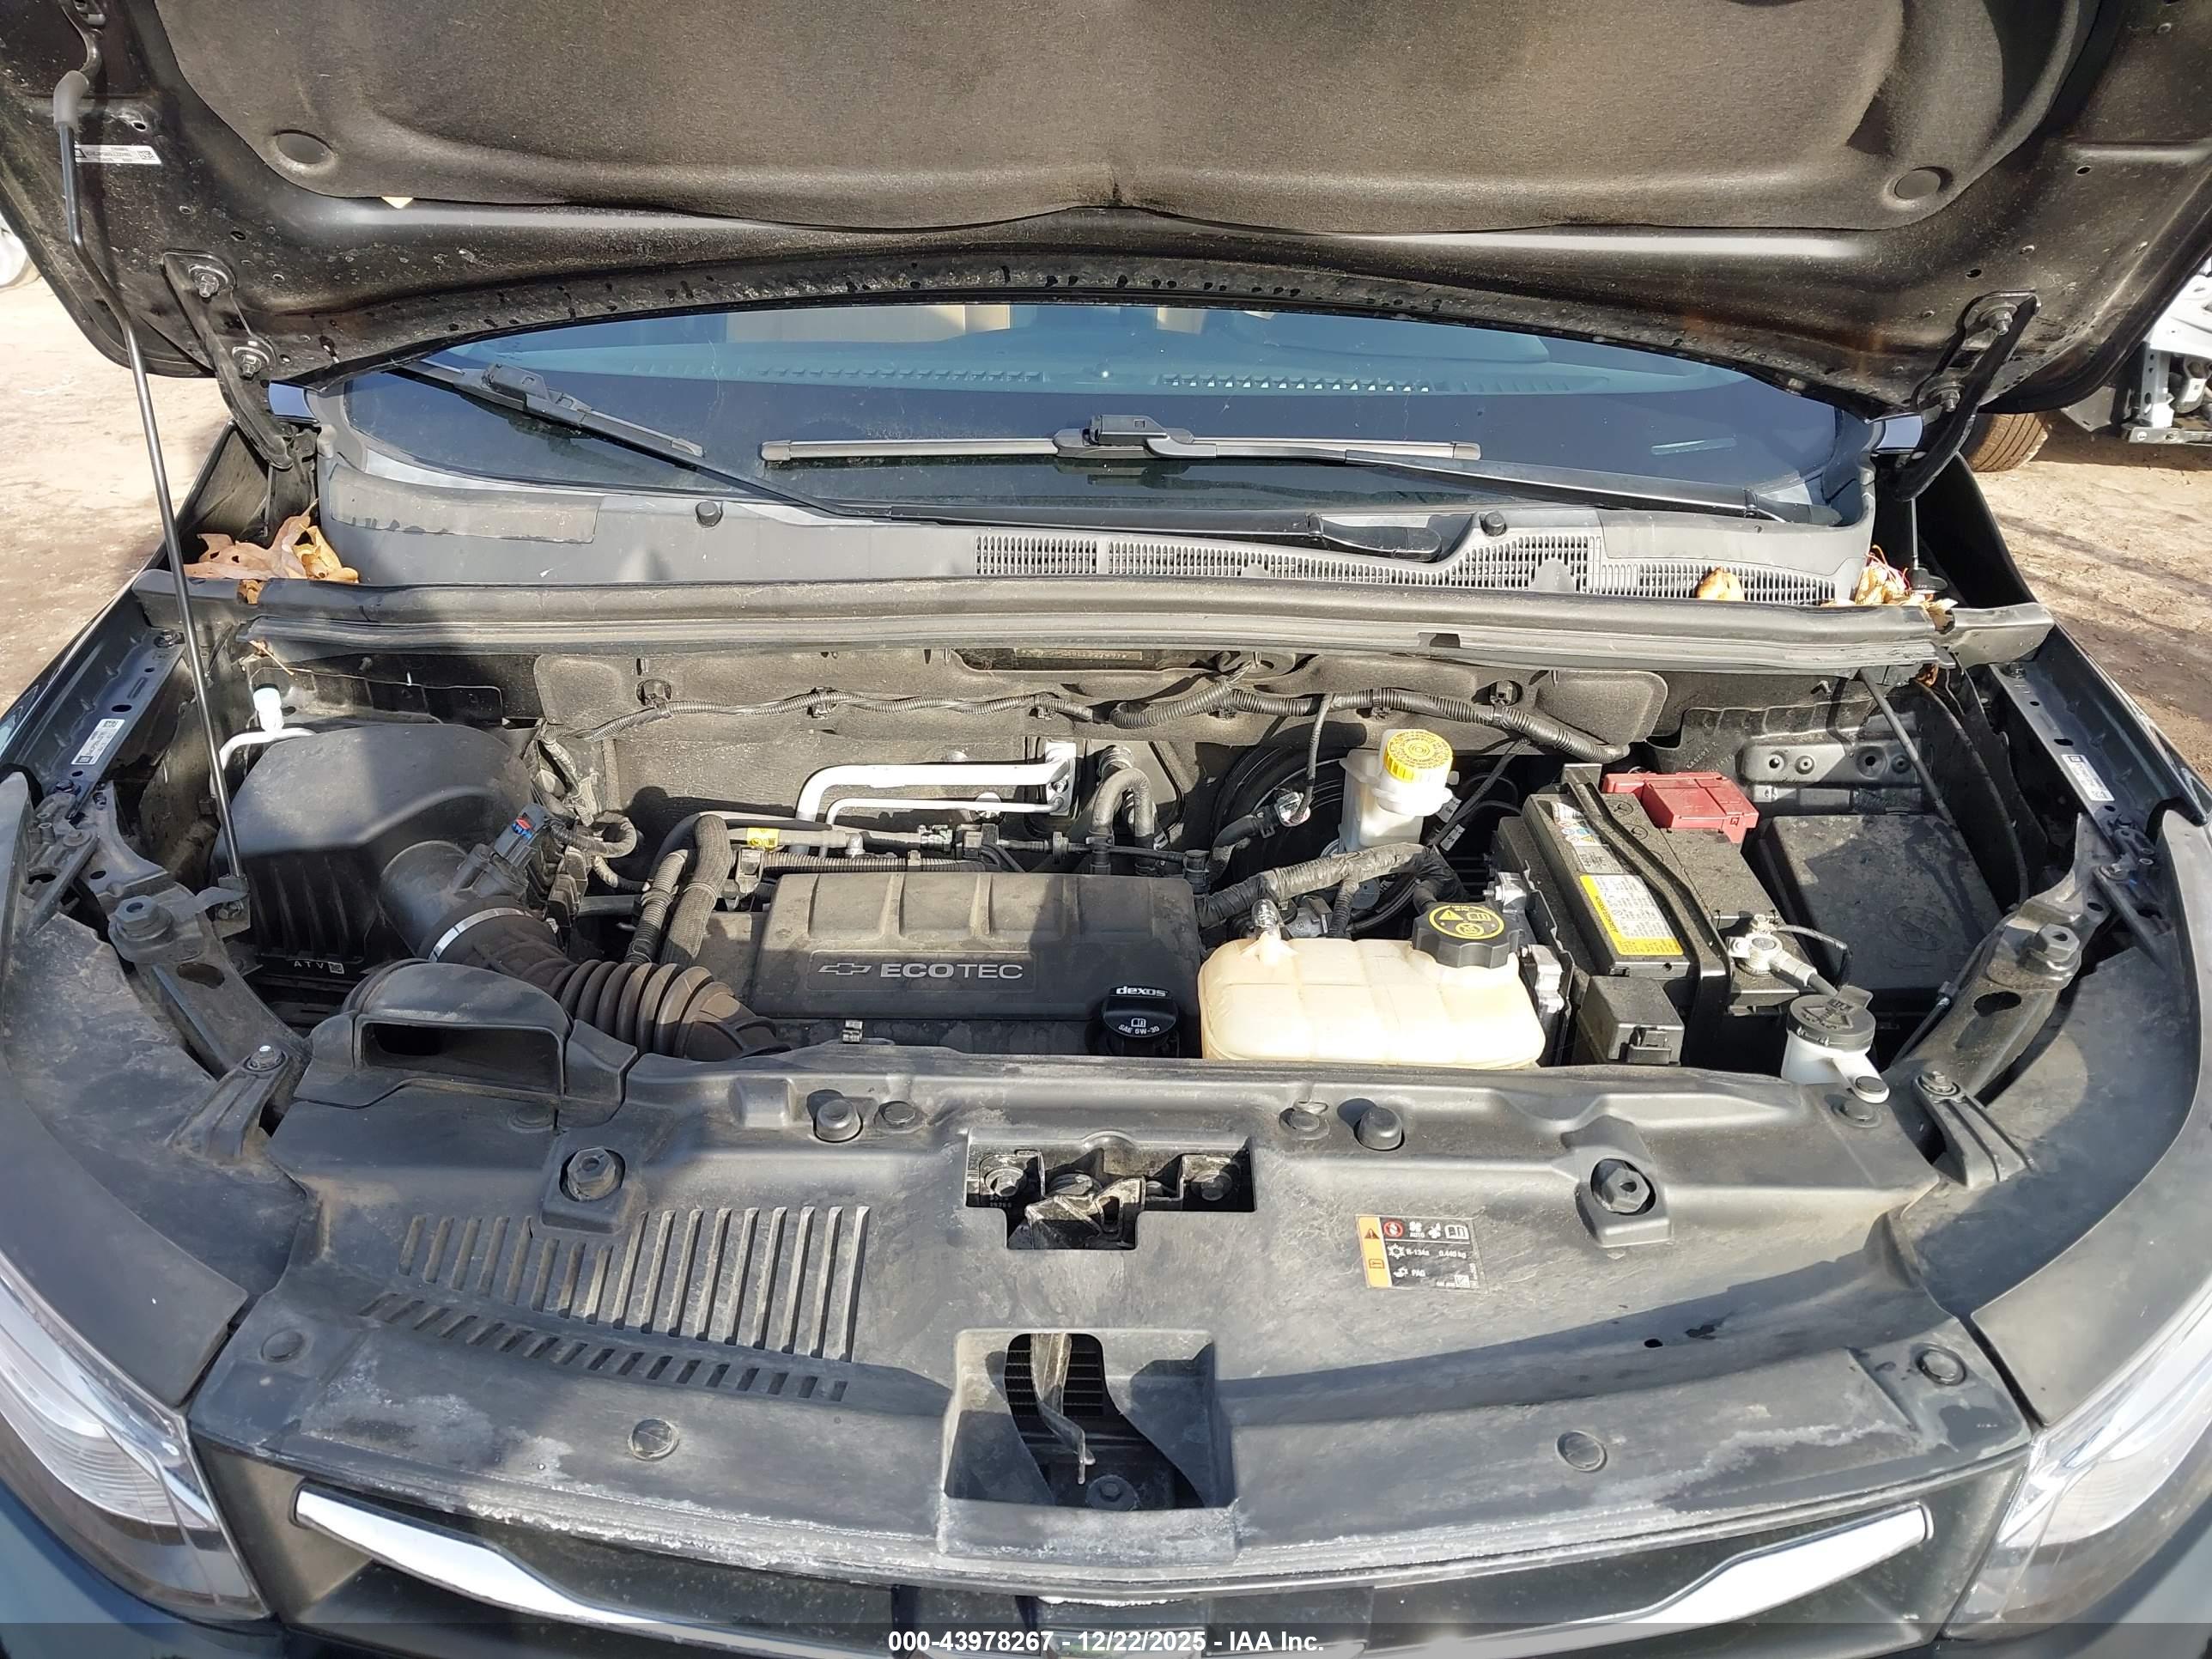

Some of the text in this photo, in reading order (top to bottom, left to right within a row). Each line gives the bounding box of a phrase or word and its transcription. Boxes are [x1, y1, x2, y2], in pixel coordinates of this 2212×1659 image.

[880, 963, 1024, 979] ECOTEC
[1116, 986, 1166, 997] dexos
[1119, 1024, 1133, 1034] SAE
